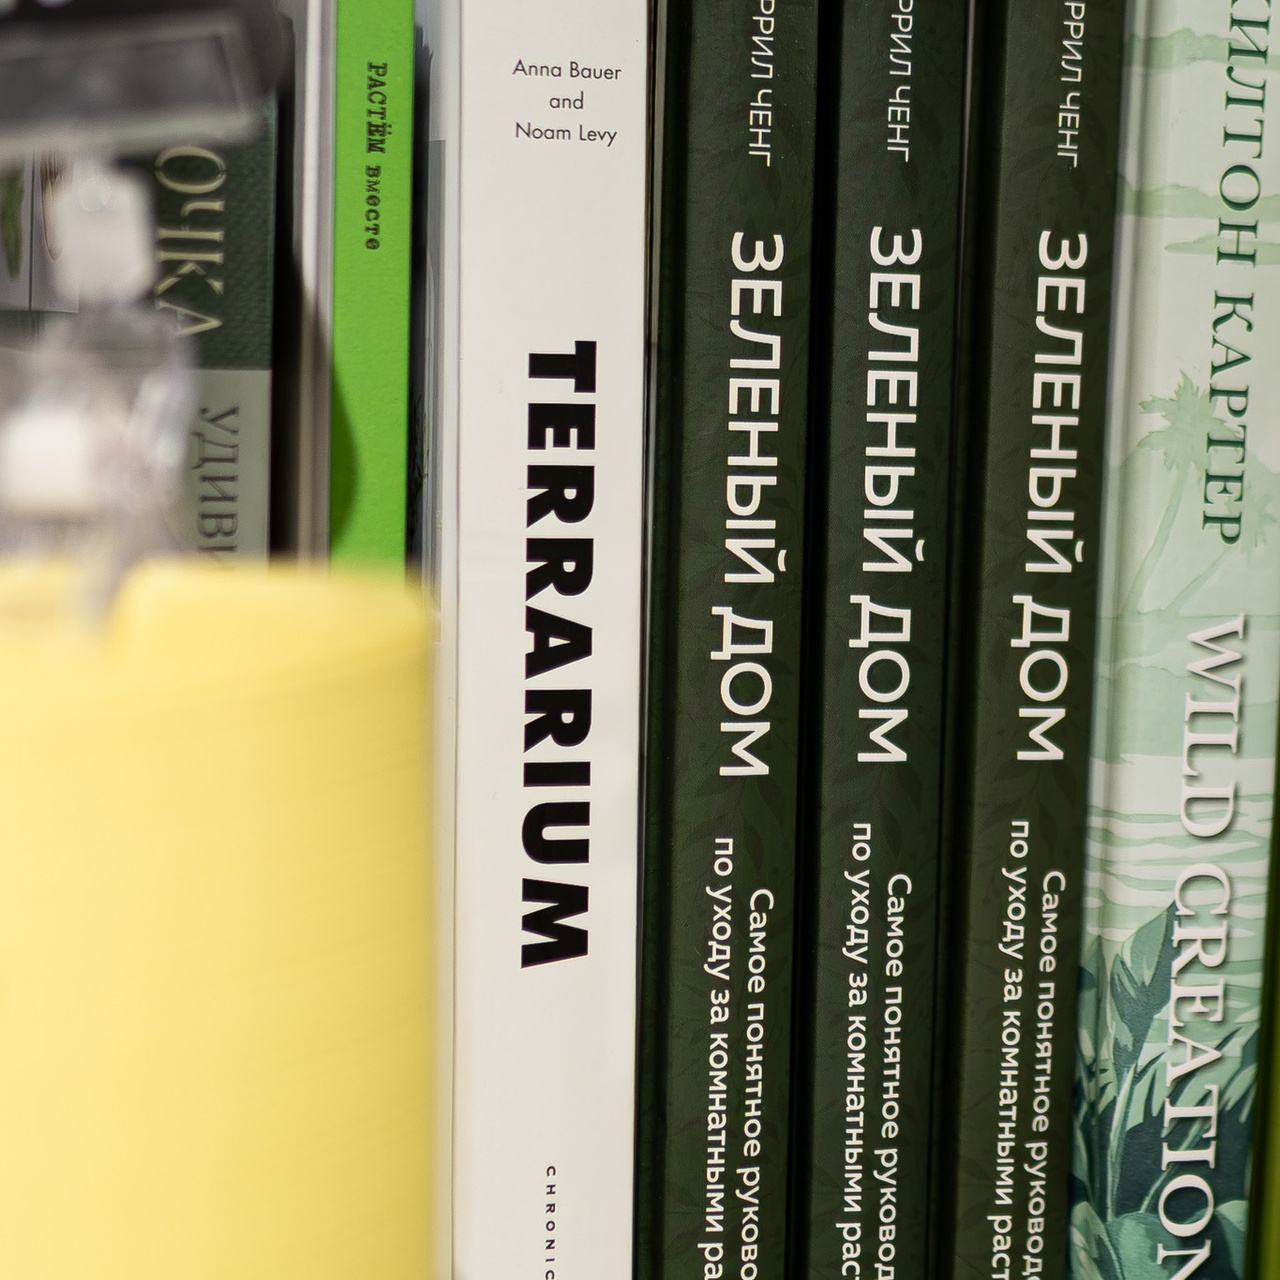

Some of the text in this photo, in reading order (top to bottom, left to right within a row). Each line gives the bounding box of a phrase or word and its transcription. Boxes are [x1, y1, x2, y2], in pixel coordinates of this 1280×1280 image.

[367, 62, 392, 154] РАСТЁМ
[512, 59, 622, 80] Anna Bauer
[549, 91, 584, 109] and
[515, 122, 618, 147] Noam Levy
[749, 89, 772, 167] ЧЕНГ
[887, 86, 910, 162] ЧЕНГ
[1057, 92, 1080, 168] ЧЕНГ
[1202, 288, 1256, 546] КАРТЕР
[711, 231, 787, 777] ЗЕЛЕНЫЙ ДОМ
[849, 226, 925, 763] ЗЕЛЕНЫЙ ДОМ
[1010, 230, 1088, 761] ЗЕЛЕНЫЙ ДОМ
[521, 340, 597, 969] TERRARIUM
[1181, 612, 1246, 838] WILD
[714, 837, 734, 877] по
[851, 822, 871, 862] по
[1010, 820, 1029, 859] по
[704, 884, 732, 981] уходу
[746, 888, 774, 994] Самое
[842, 869, 870, 964] уходу
[885, 873, 912, 977] Самое
[998, 867, 1028, 960] уходу
[1038, 870, 1066, 973] Самое
[709, 989, 731, 1024] за
[848, 972, 868, 1008] за
[1003, 968, 1023, 1003] за
[743, 1002, 765, 1158] понятное
[880, 986, 903, 1140] понятное
[1032, 982, 1055, 1133] понятное
[705, 1032, 729, 1234] комнатными
[843, 1015, 867, 1213] комнатными
[994, 1010, 1021, 1207] комнатными
